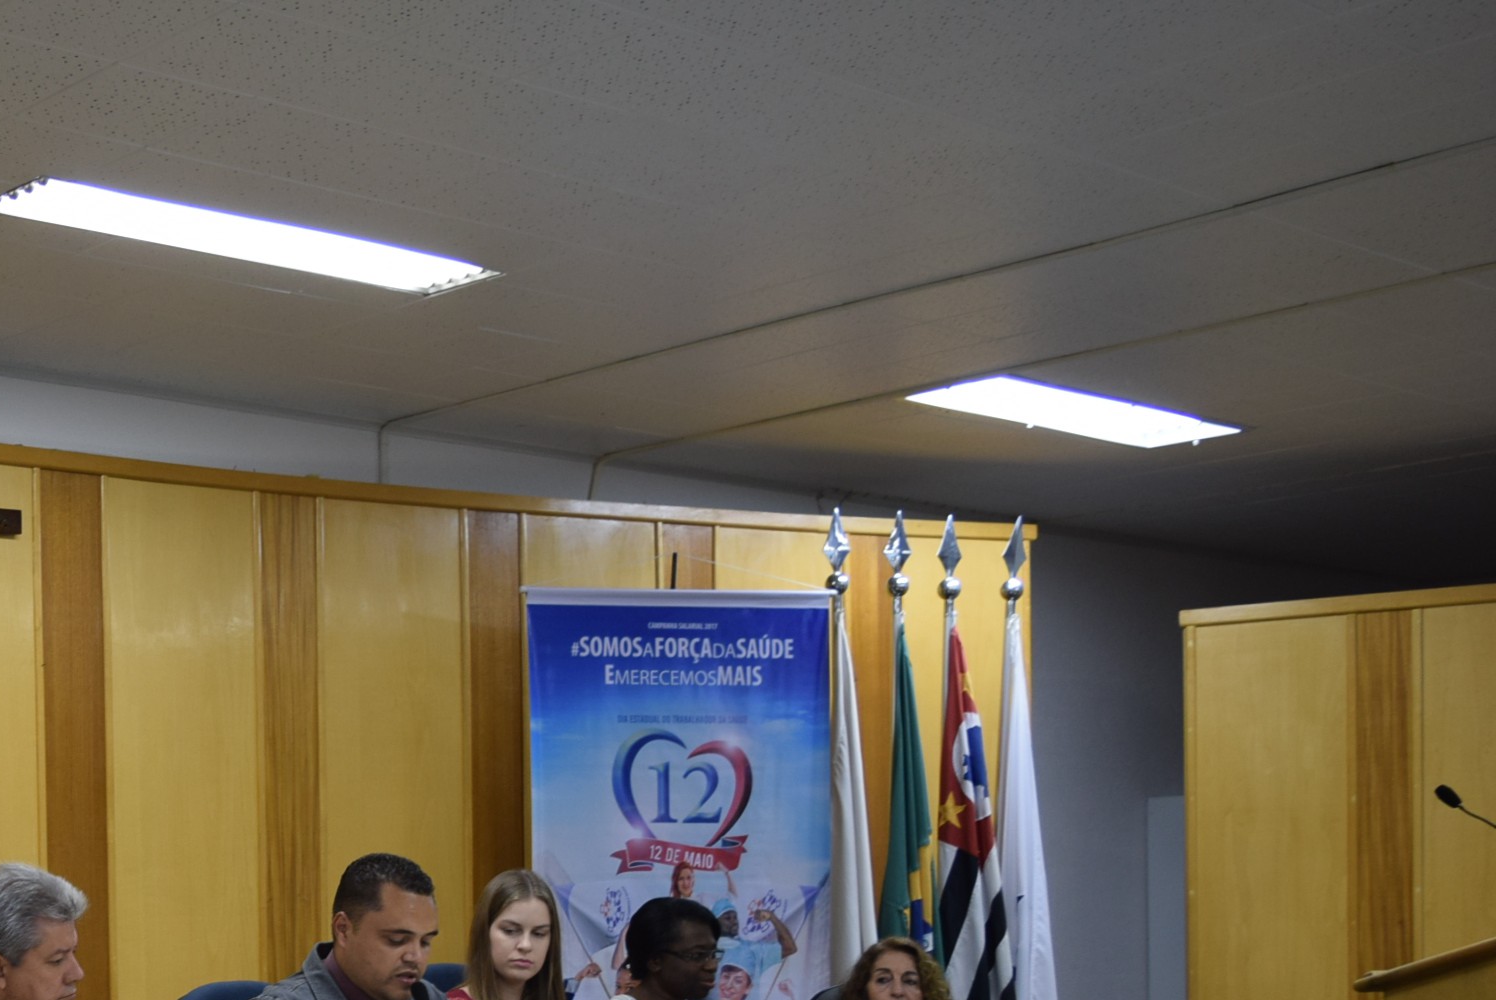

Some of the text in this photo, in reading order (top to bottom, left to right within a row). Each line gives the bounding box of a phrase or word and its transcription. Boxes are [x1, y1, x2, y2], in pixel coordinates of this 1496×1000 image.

[648, 760, 723, 824] 12
[649, 845, 714, 869] 12 DE MAIO
